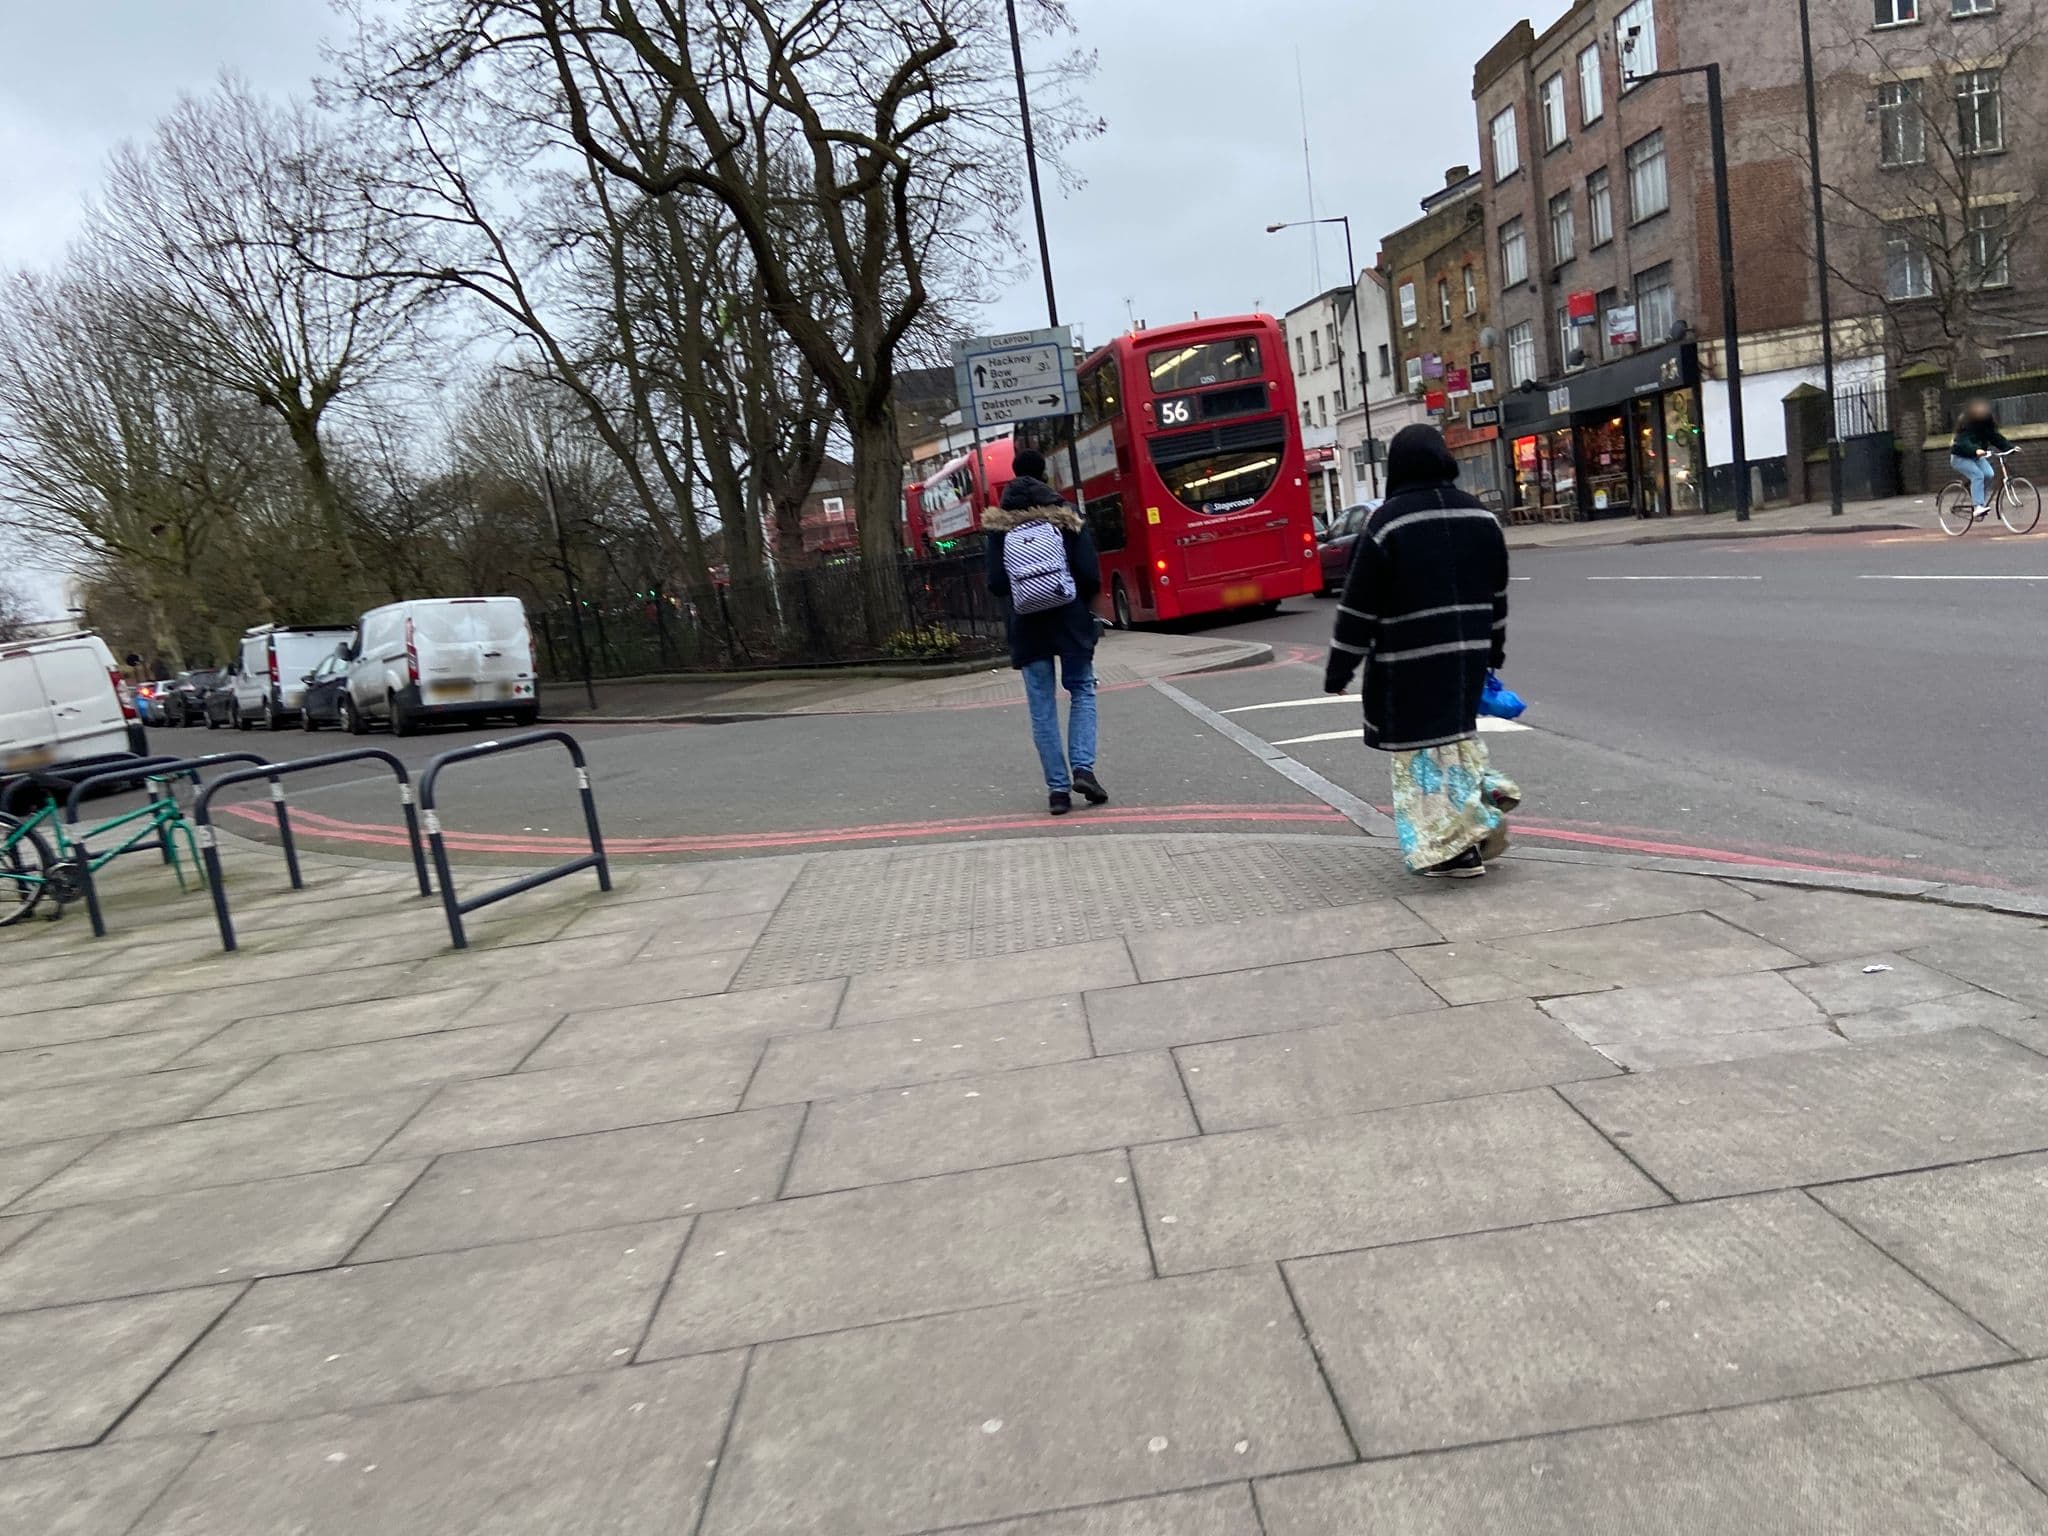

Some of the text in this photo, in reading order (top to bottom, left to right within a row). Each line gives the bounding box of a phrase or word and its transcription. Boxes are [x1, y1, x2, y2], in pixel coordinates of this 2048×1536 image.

[992, 335, 1030, 347] CLAPTON
[988, 355, 1032, 367] Hackney
[990, 369, 1012, 378] Bow
[992, 380, 1001, 390] A
[982, 398, 1022, 410] Dalston
[984, 412, 992, 421] A
[1162, 401, 1189, 424] 56
